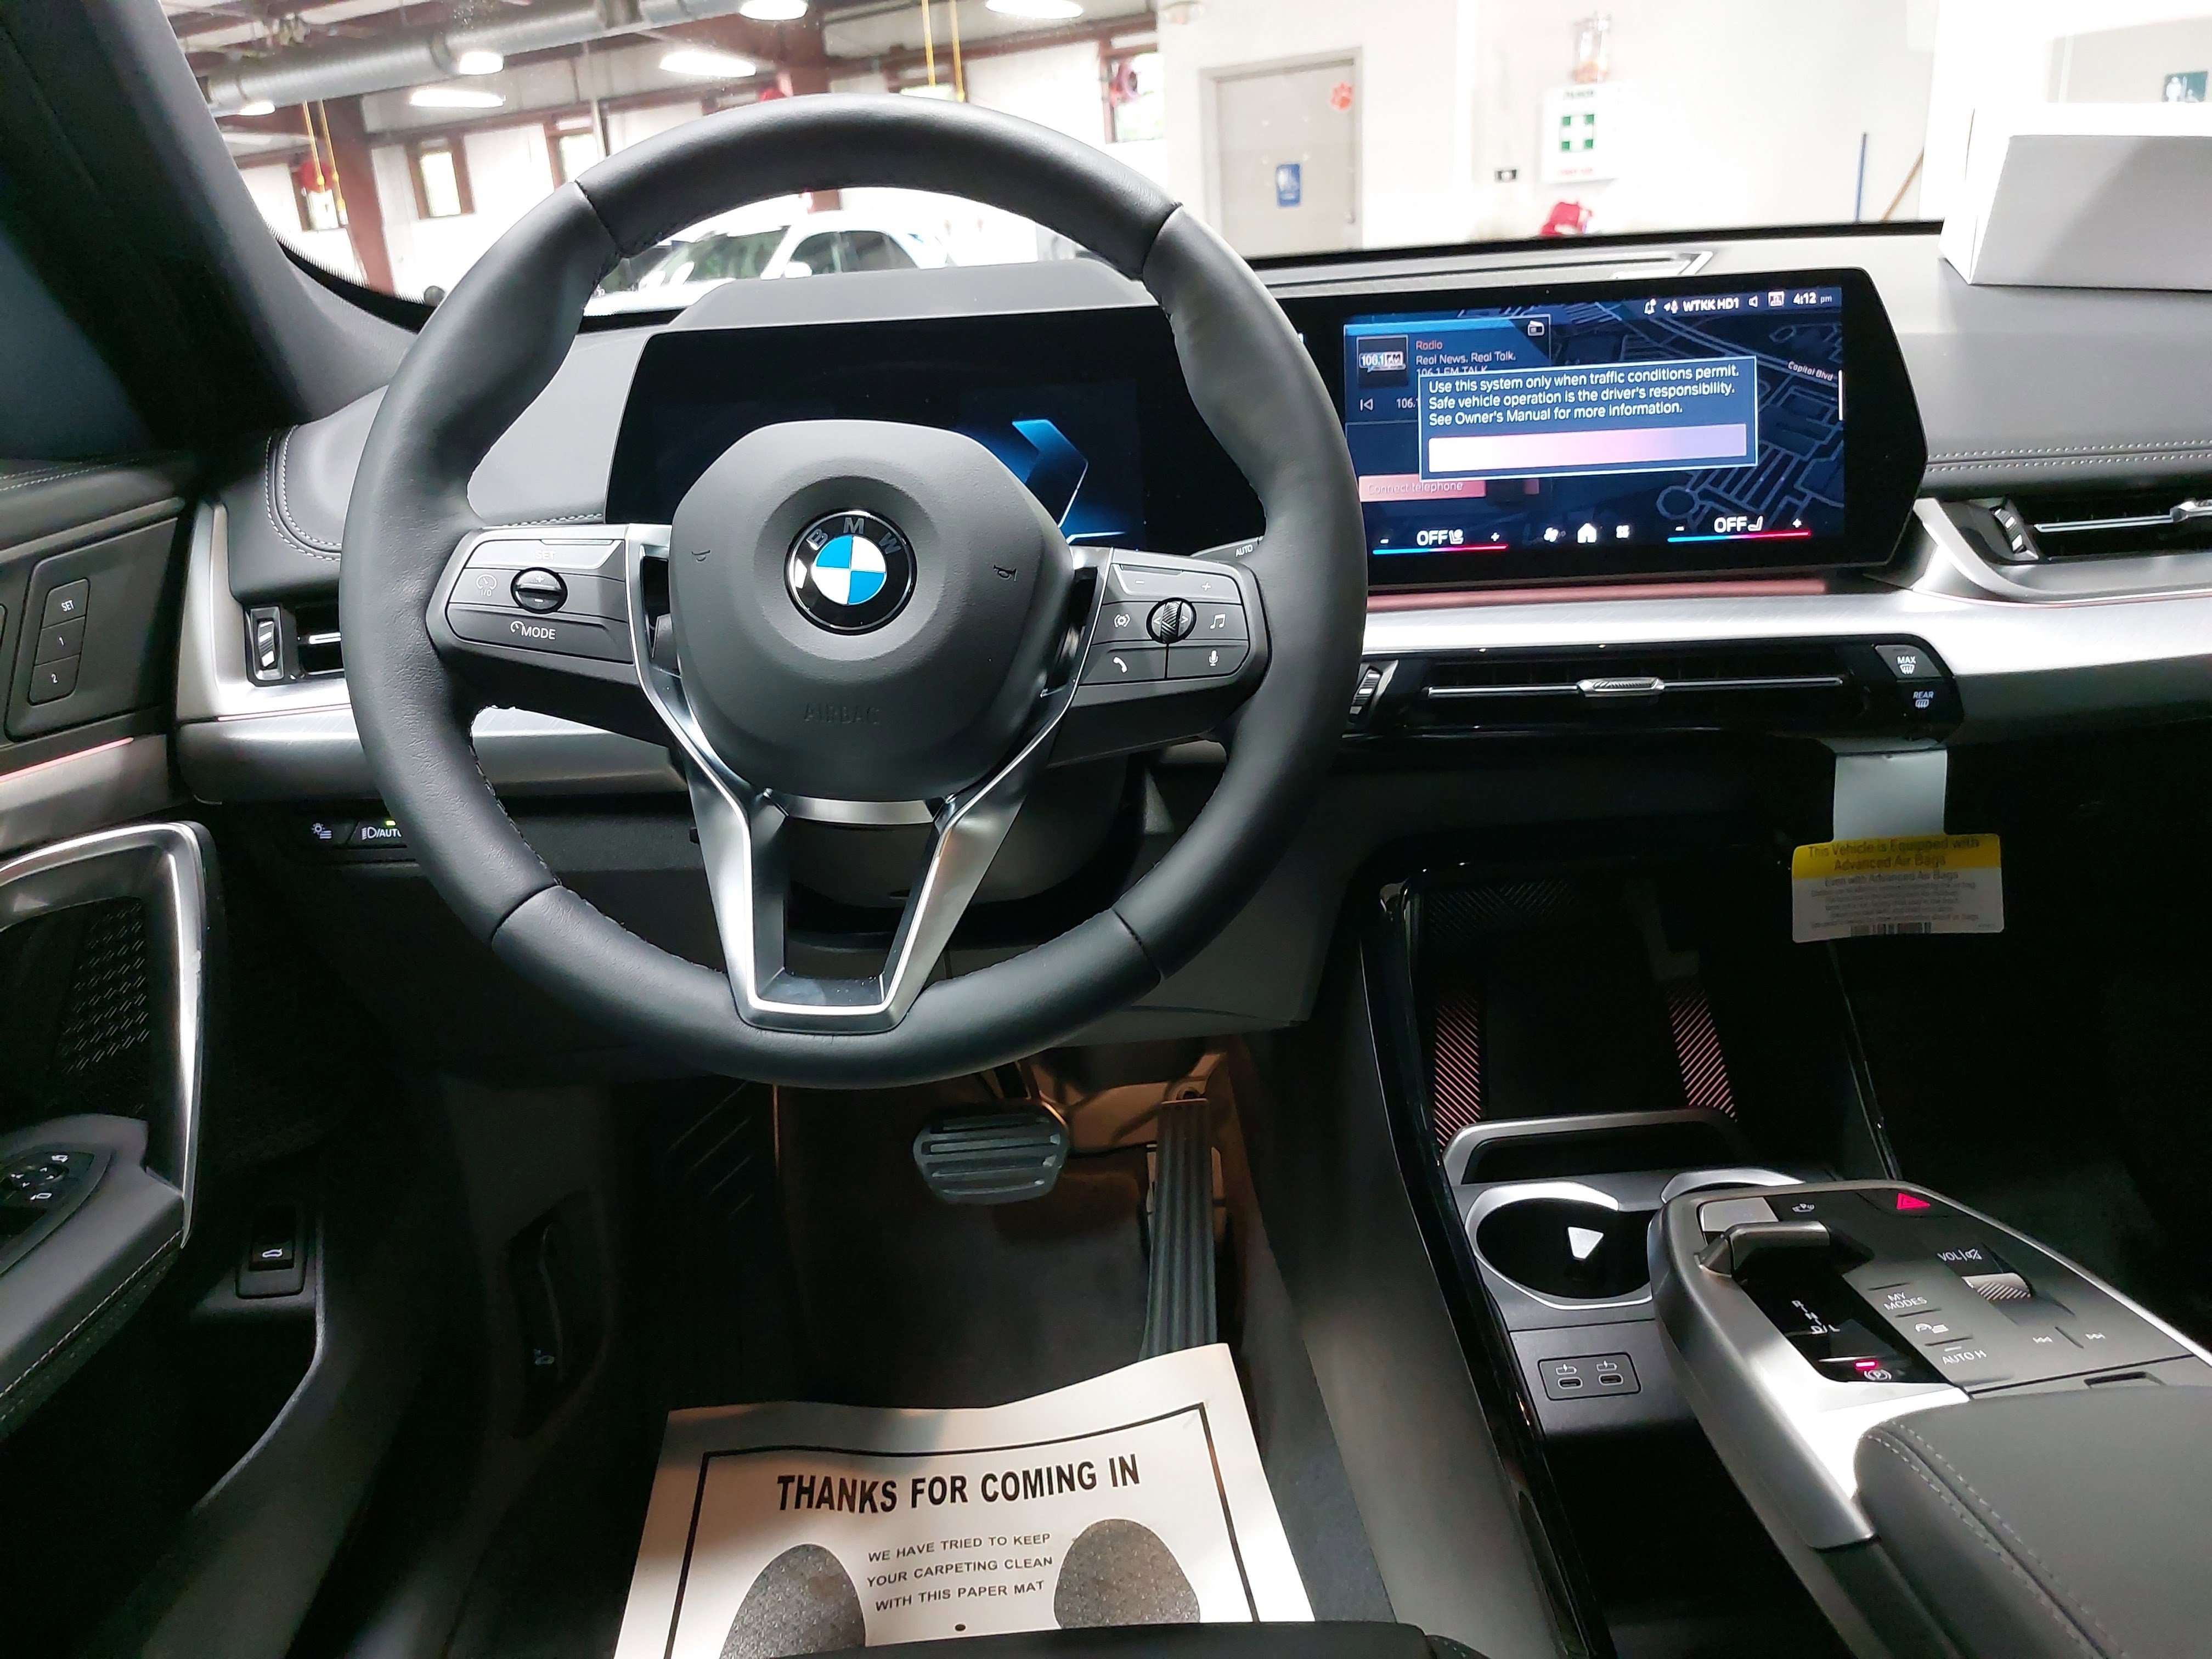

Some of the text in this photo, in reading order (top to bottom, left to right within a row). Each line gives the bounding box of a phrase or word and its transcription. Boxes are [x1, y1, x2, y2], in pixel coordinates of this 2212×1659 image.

[1683, 297, 1739, 312] WTKK HD1
[1793, 292, 1817, 304] 4:12
[1416, 340, 1443, 351] Radio
[1416, 351, 1516, 365] Real News. Real Talk.
[1429, 364, 1739, 393] Use this system only when traffic conditions permit.
[1429, 382, 1735, 409] Safe vehicle operation is the driver's responsibility.
[1429, 402, 1683, 426] See Owner's Manual for more information.
[1367, 481, 1464, 494] Connect telephone
[1714, 516, 1747, 533] OFF
[1417, 530, 1448, 545] OFF
[535, 549, 556, 560] SET
[1235, 544, 1253, 557] AUTO
[61, 600, 75, 612] SET
[521, 625, 556, 640] MODE
[59, 636, 64, 646] 1
[1897, 656, 1916, 664] MAX
[51, 673, 58, 684] 2
[1913, 691, 1934, 699] REAR
[1883, 1296, 1928, 1311] MODES
[1887, 1291, 1906, 1302] MY
[1941, 1352, 1974, 1365] AUTO
[777, 1453, 1141, 1514] THANKS FOR COMING IN
[868, 1533, 1051, 1562] WE HAVE TRIED TO KEEP
[867, 1556, 1053, 1587] YOUR CARPETING CLEAN
[875, 1580, 1045, 1612] WITH THIS PAPER MAT
